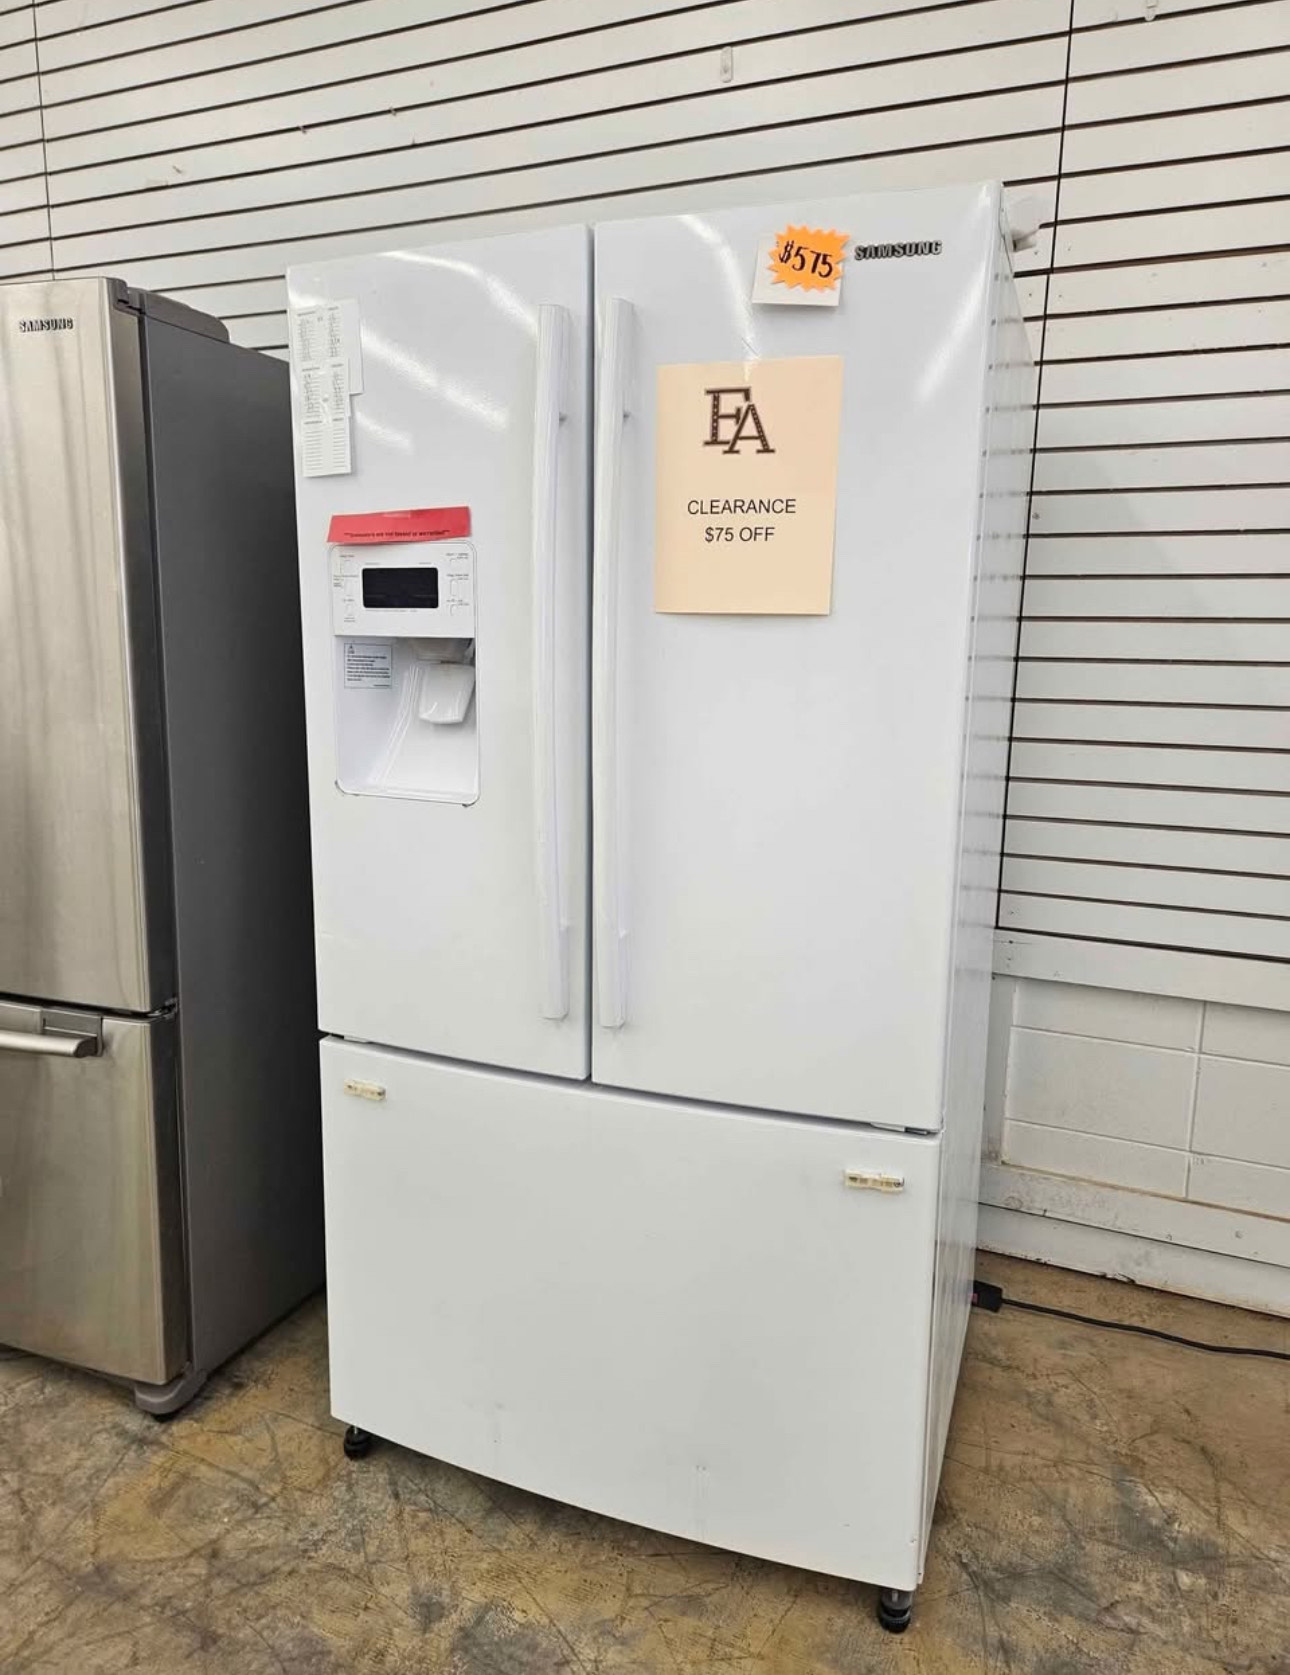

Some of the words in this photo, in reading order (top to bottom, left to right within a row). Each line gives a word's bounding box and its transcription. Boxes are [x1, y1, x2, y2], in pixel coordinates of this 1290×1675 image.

[778, 240, 833, 278] $575
[854, 240, 943, 261] SAMSUNG
[19, 317, 74, 333] SAMSUNG
[687, 499, 796, 515] CLEARANCE
[704, 526, 735, 543] $75
[739, 527, 775, 542] OFF
